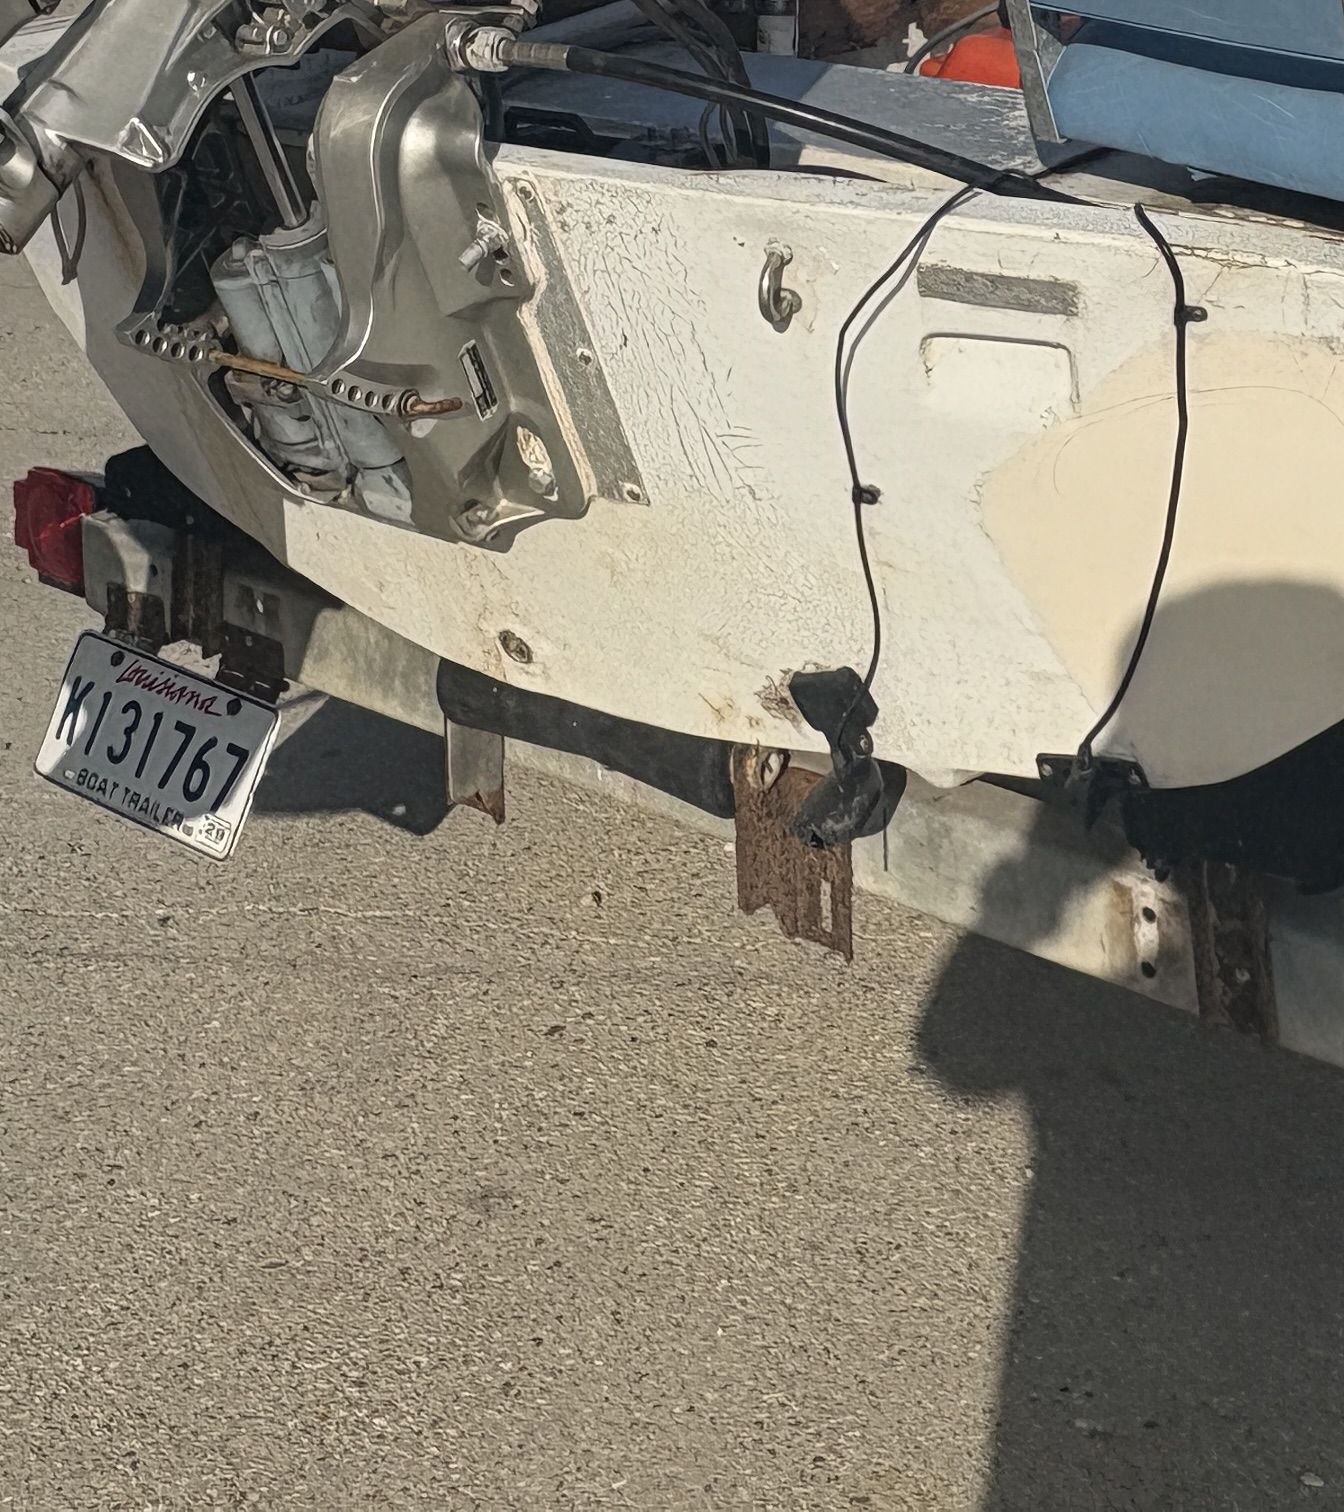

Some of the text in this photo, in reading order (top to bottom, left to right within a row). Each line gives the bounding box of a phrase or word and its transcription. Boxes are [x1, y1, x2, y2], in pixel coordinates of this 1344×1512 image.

[116, 661, 222, 716] Louisiana
[57, 676, 248, 812] K131767
[77, 769, 184, 831] BOAT TRAILER
